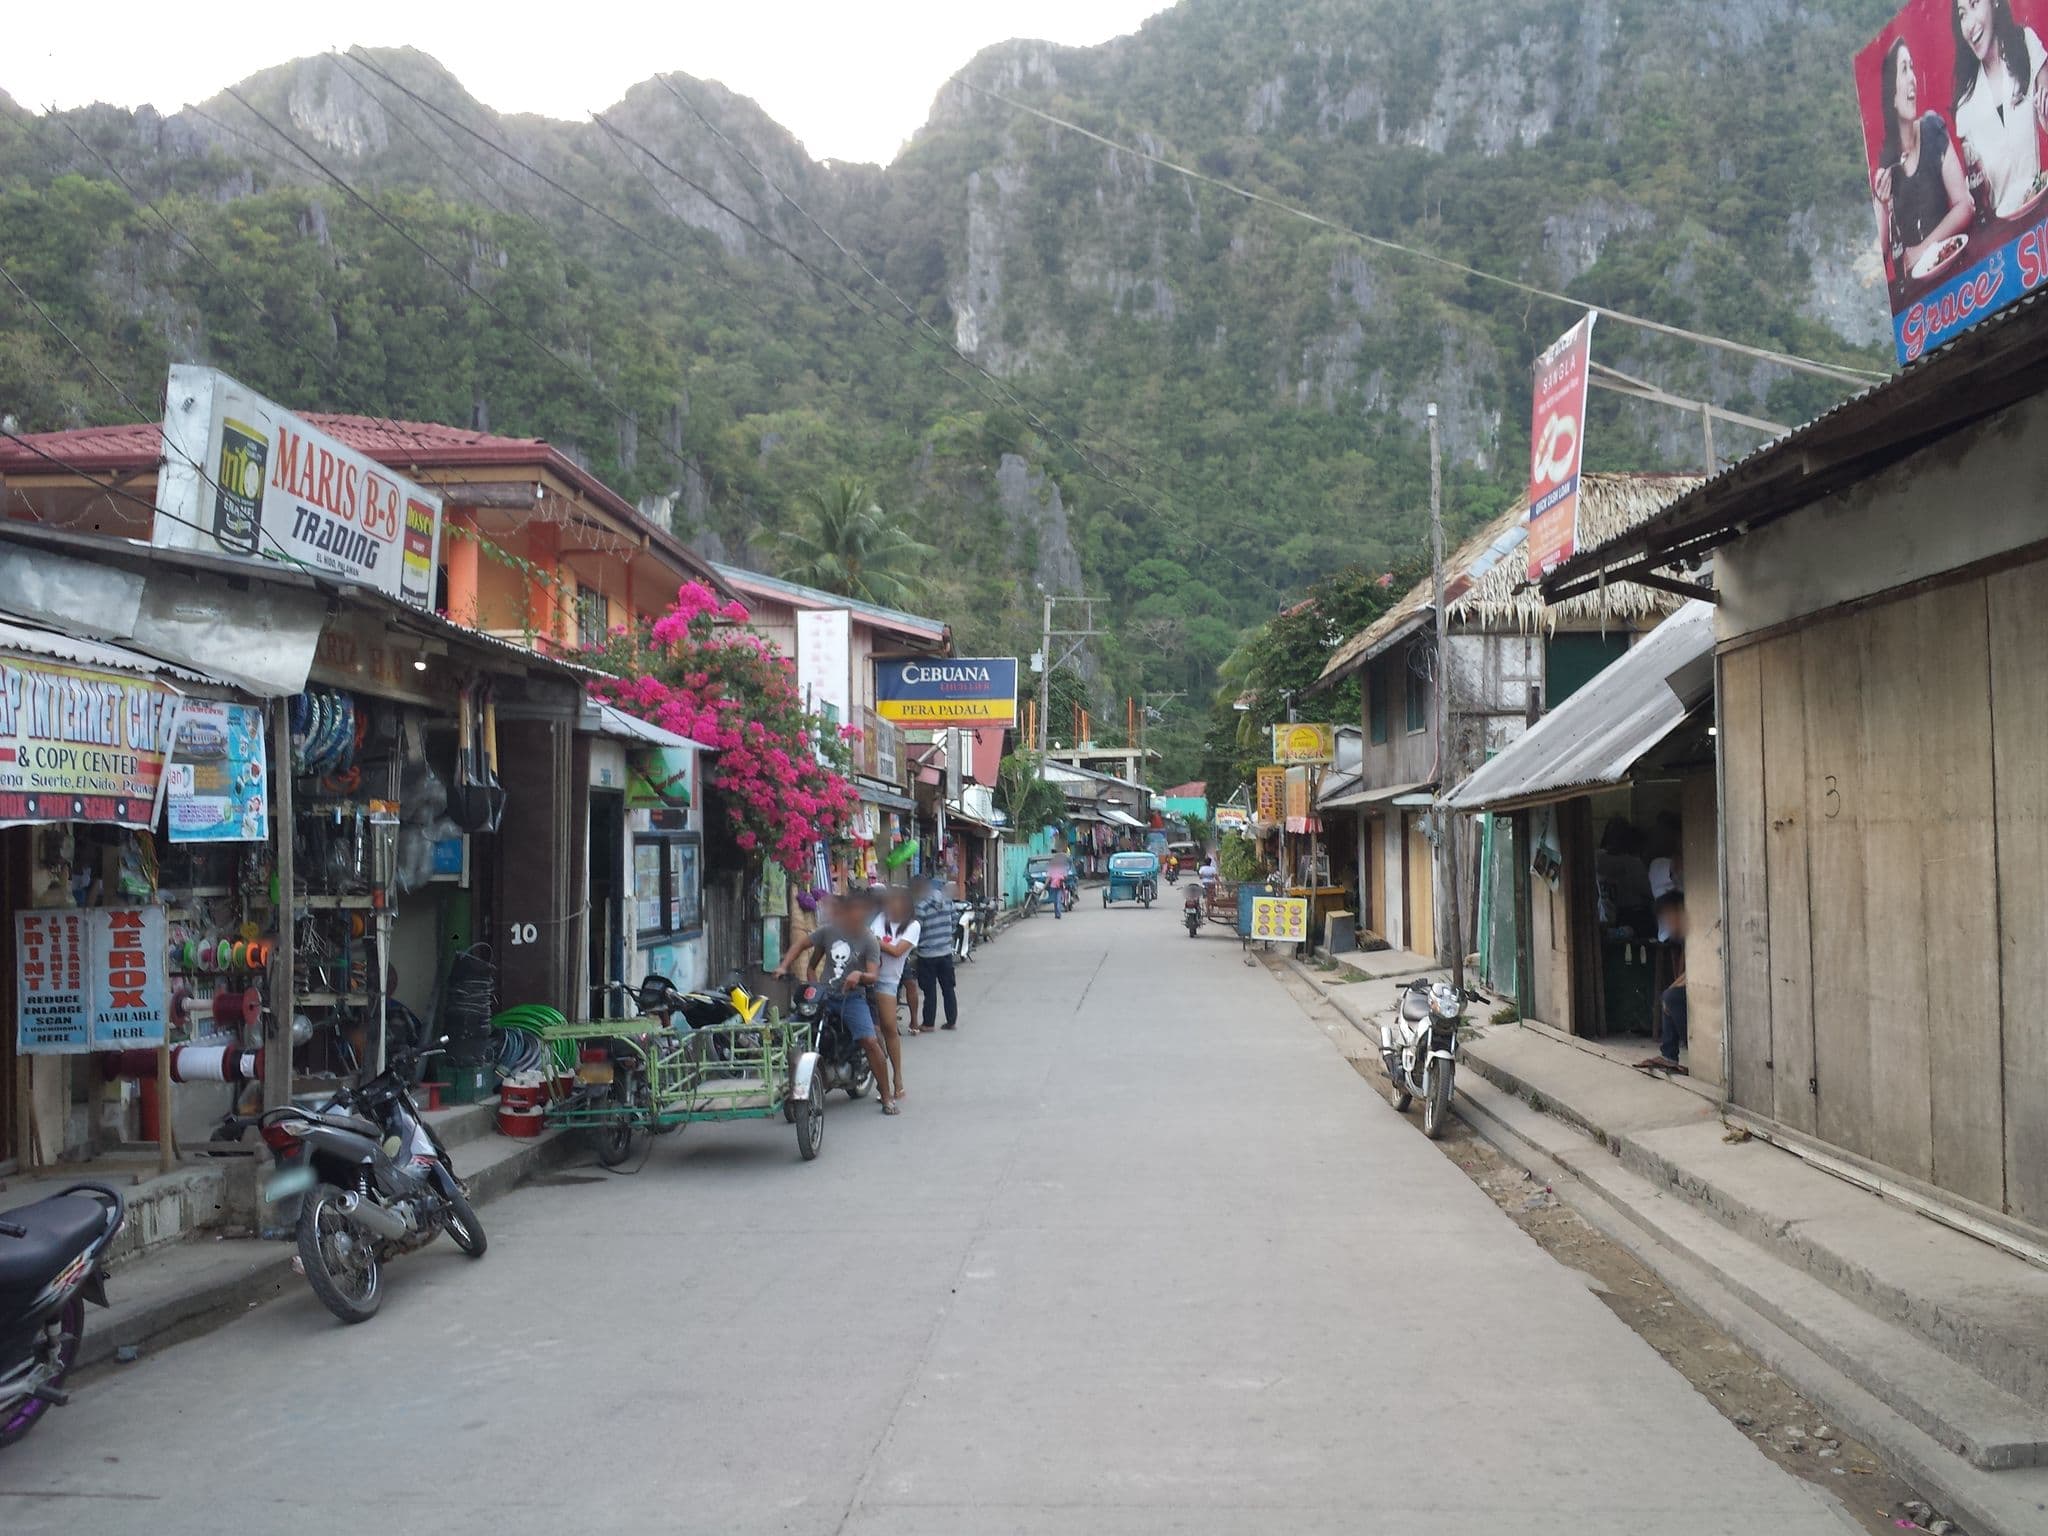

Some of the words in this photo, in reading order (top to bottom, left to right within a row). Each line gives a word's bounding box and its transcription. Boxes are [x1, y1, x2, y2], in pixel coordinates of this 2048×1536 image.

[2017, 216, 2048, 289] SI
[1543, 353, 1576, 395] SANGLA
[272, 426, 357, 522] MARIS
[364, 476, 397, 538] B-8
[292, 505, 380, 570] TRADING
[901, 664, 991, 685] CEBUANA
[26, 670, 125, 748] INTERNET
[902, 705, 936, 716] PERA
[939, 704, 989, 716] PADALA
[18, 745, 30, 769] &
[36, 746, 78, 771] COPY
[82, 751, 138, 776] CENTER
[31, 772, 75, 789] Suerte,
[76, 775, 86, 789] El
[89, 776, 119, 792] Nido,
[1825, 775, 1841, 818] 3
[511, 922, 537, 945] 10
[24, 916, 45, 991] PRINT
[107, 910, 147, 1009] XEROX
[24, 1005, 82, 1015] ENLARGE
[27, 994, 80, 1004] REDUCE
[36, 1016, 72, 1025] SCAN
[97, 1010, 161, 1023] AVAILABLE
[37, 1034, 70, 1043] HERE
[113, 1026, 145, 1038] HERE
